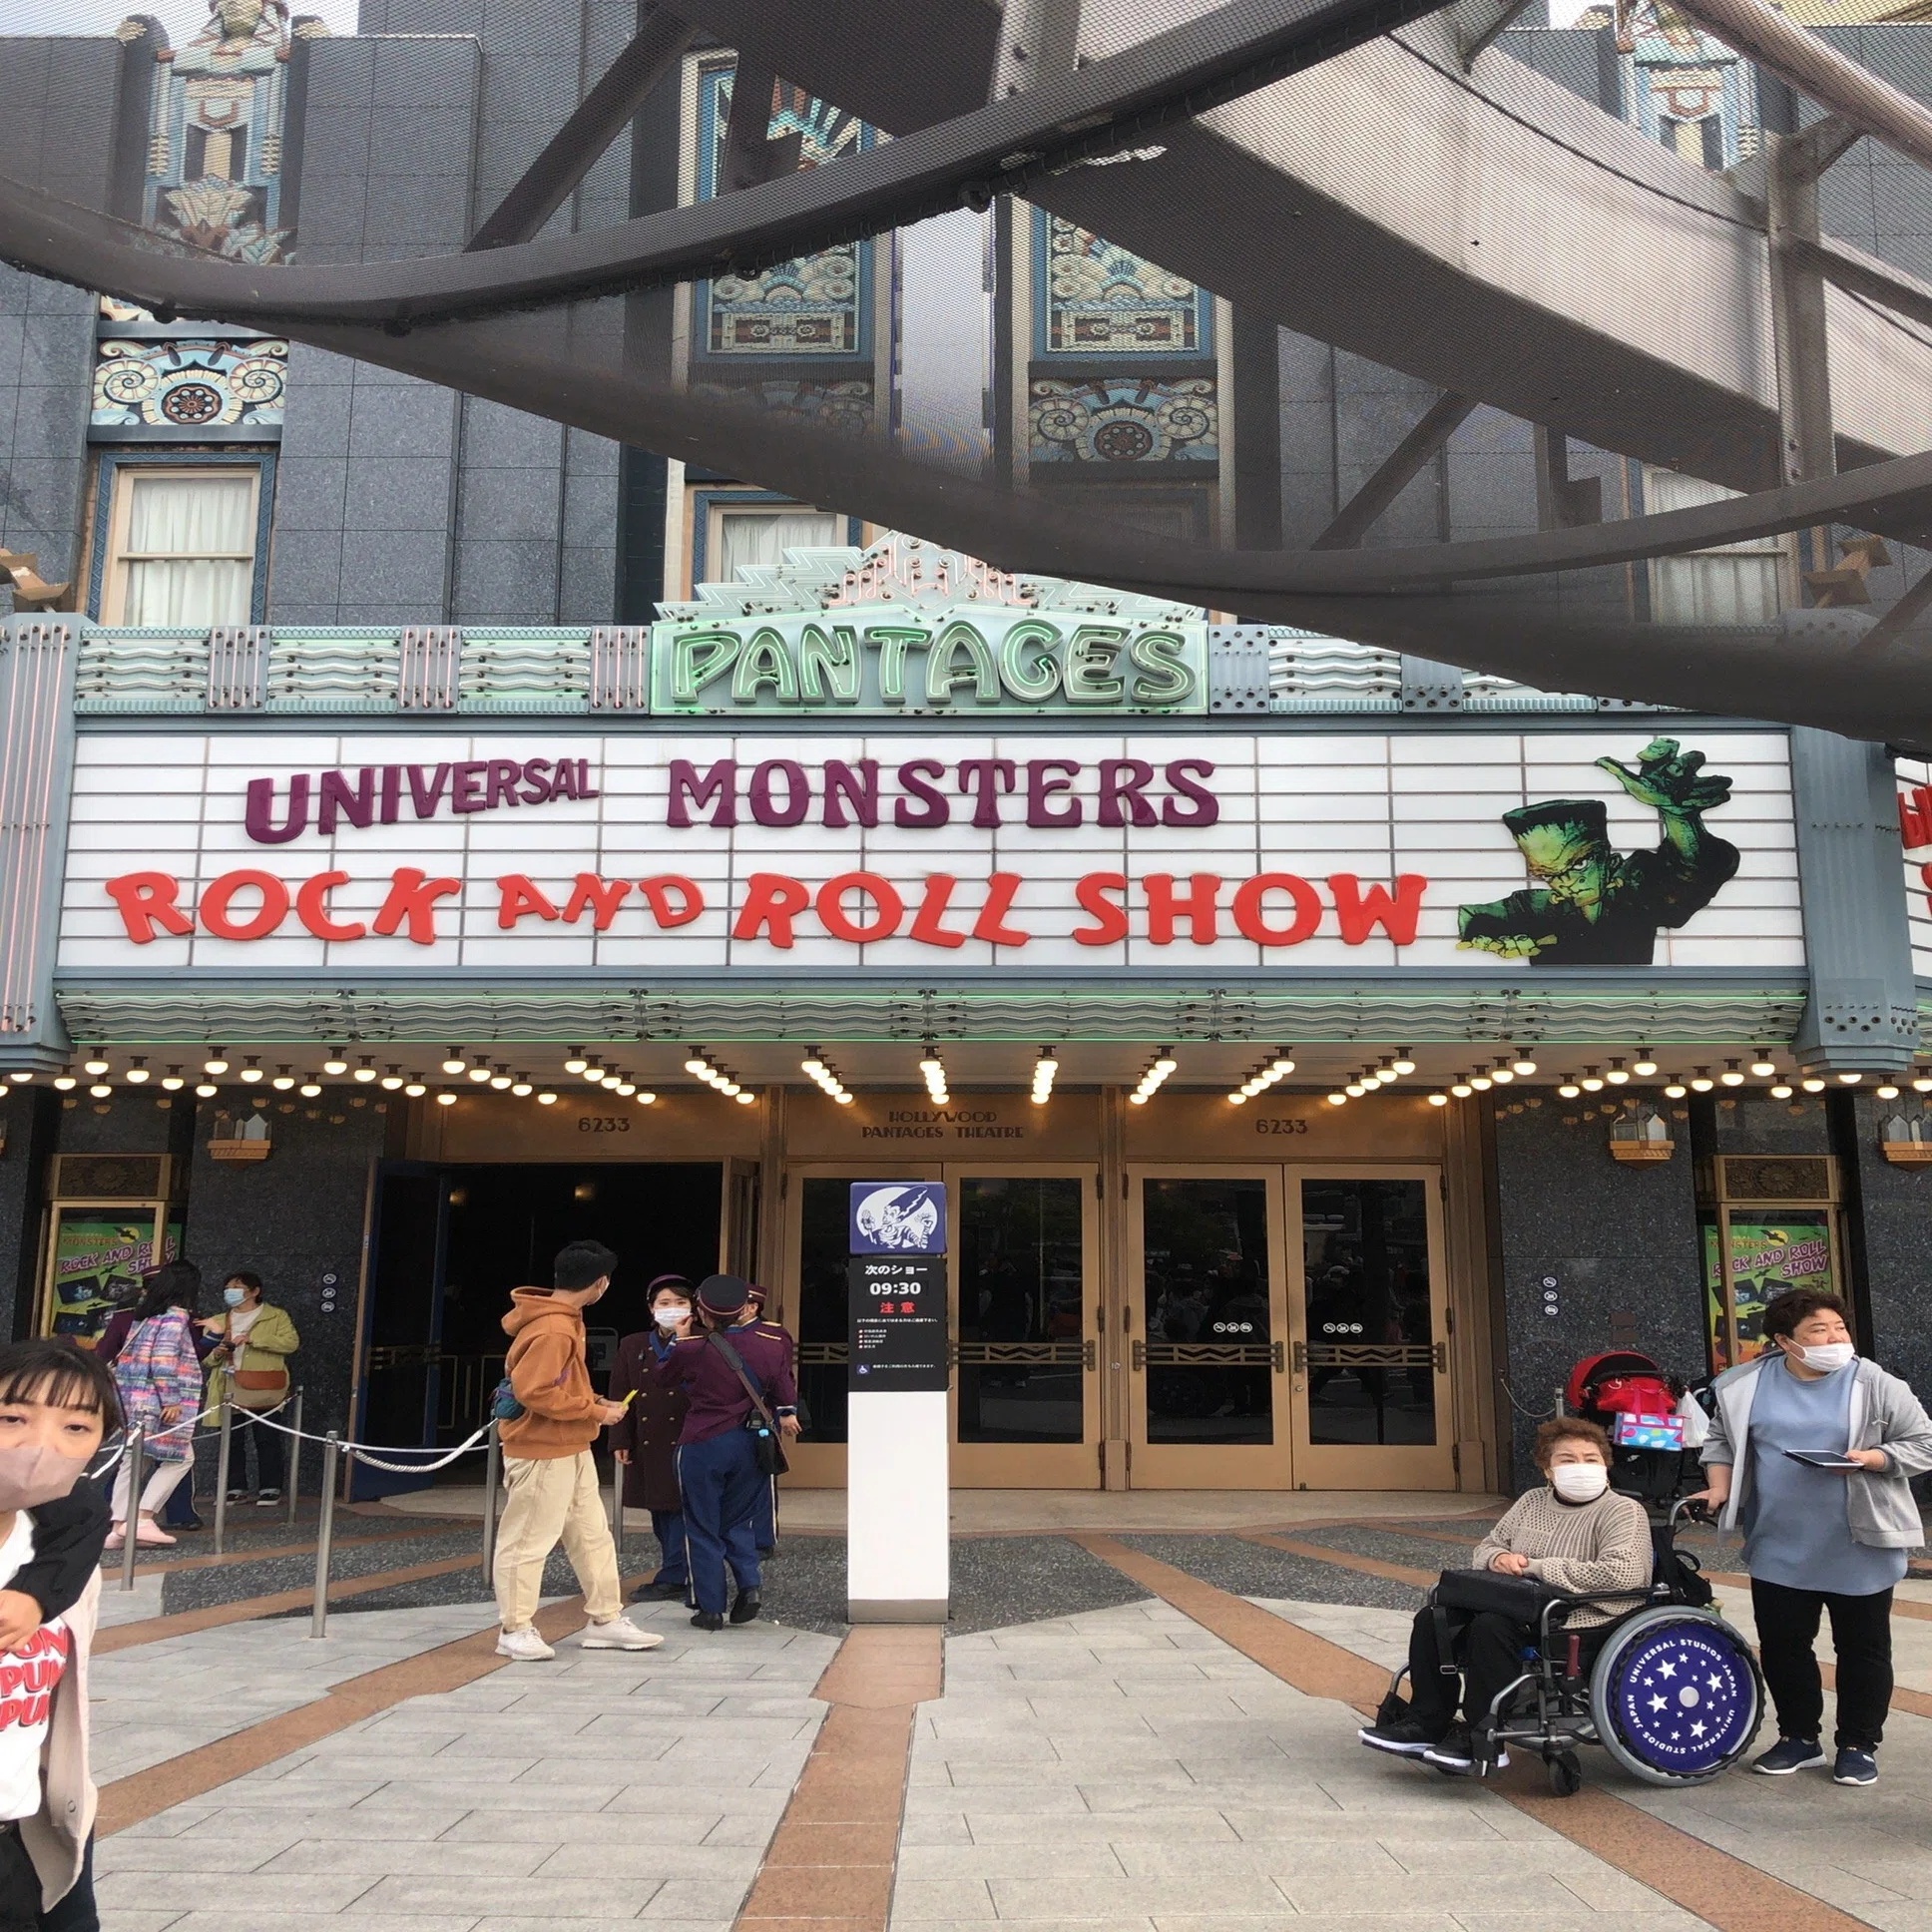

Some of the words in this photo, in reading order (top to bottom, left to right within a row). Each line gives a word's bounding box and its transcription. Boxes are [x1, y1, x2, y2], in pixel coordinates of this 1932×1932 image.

[670, 618, 1199, 704] PANTAGES
[244, 757, 600, 845] UNIVERSAL
[667, 758, 1220, 829] MONSTERS
[105, 866, 462, 946] ROCK
[497, 872, 706, 932] AND
[731, 870, 1031, 950] ROLL
[1072, 871, 1429, 947] SHOW
[578, 1117, 631, 1133] 6233
[888, 1111, 998, 1123] HOLLYWOOD
[1255, 1119, 1308, 1135] 6233
[861, 1126, 944, 1139] PANTAGES
[954, 1126, 1025, 1139] THEATRE
[60, 1253, 99, 1274] ROCK
[102, 1244, 134, 1264] AND
[864, 1264, 928, 1275] 次のショー
[1712, 1254, 1750, 1278] RCK
[1753, 1247, 1785, 1267] AND
[1787, 1238, 1827, 1261] ROLL
[1779, 1253, 1828, 1278] SHOW
[869, 1281, 921, 1295] 09:30
[1629, 1640, 1677, 1684] UNIVERSAL
[1680, 1638, 1723, 1662] STUDIOS
[1721, 1663, 1737, 1697] JAPAN
[1627, 1694, 1644, 1728] JAPAN
[1642, 1730, 1687, 1754] STUDIOS
[1691, 1708, 1735, 1752] UNIVERSAL
